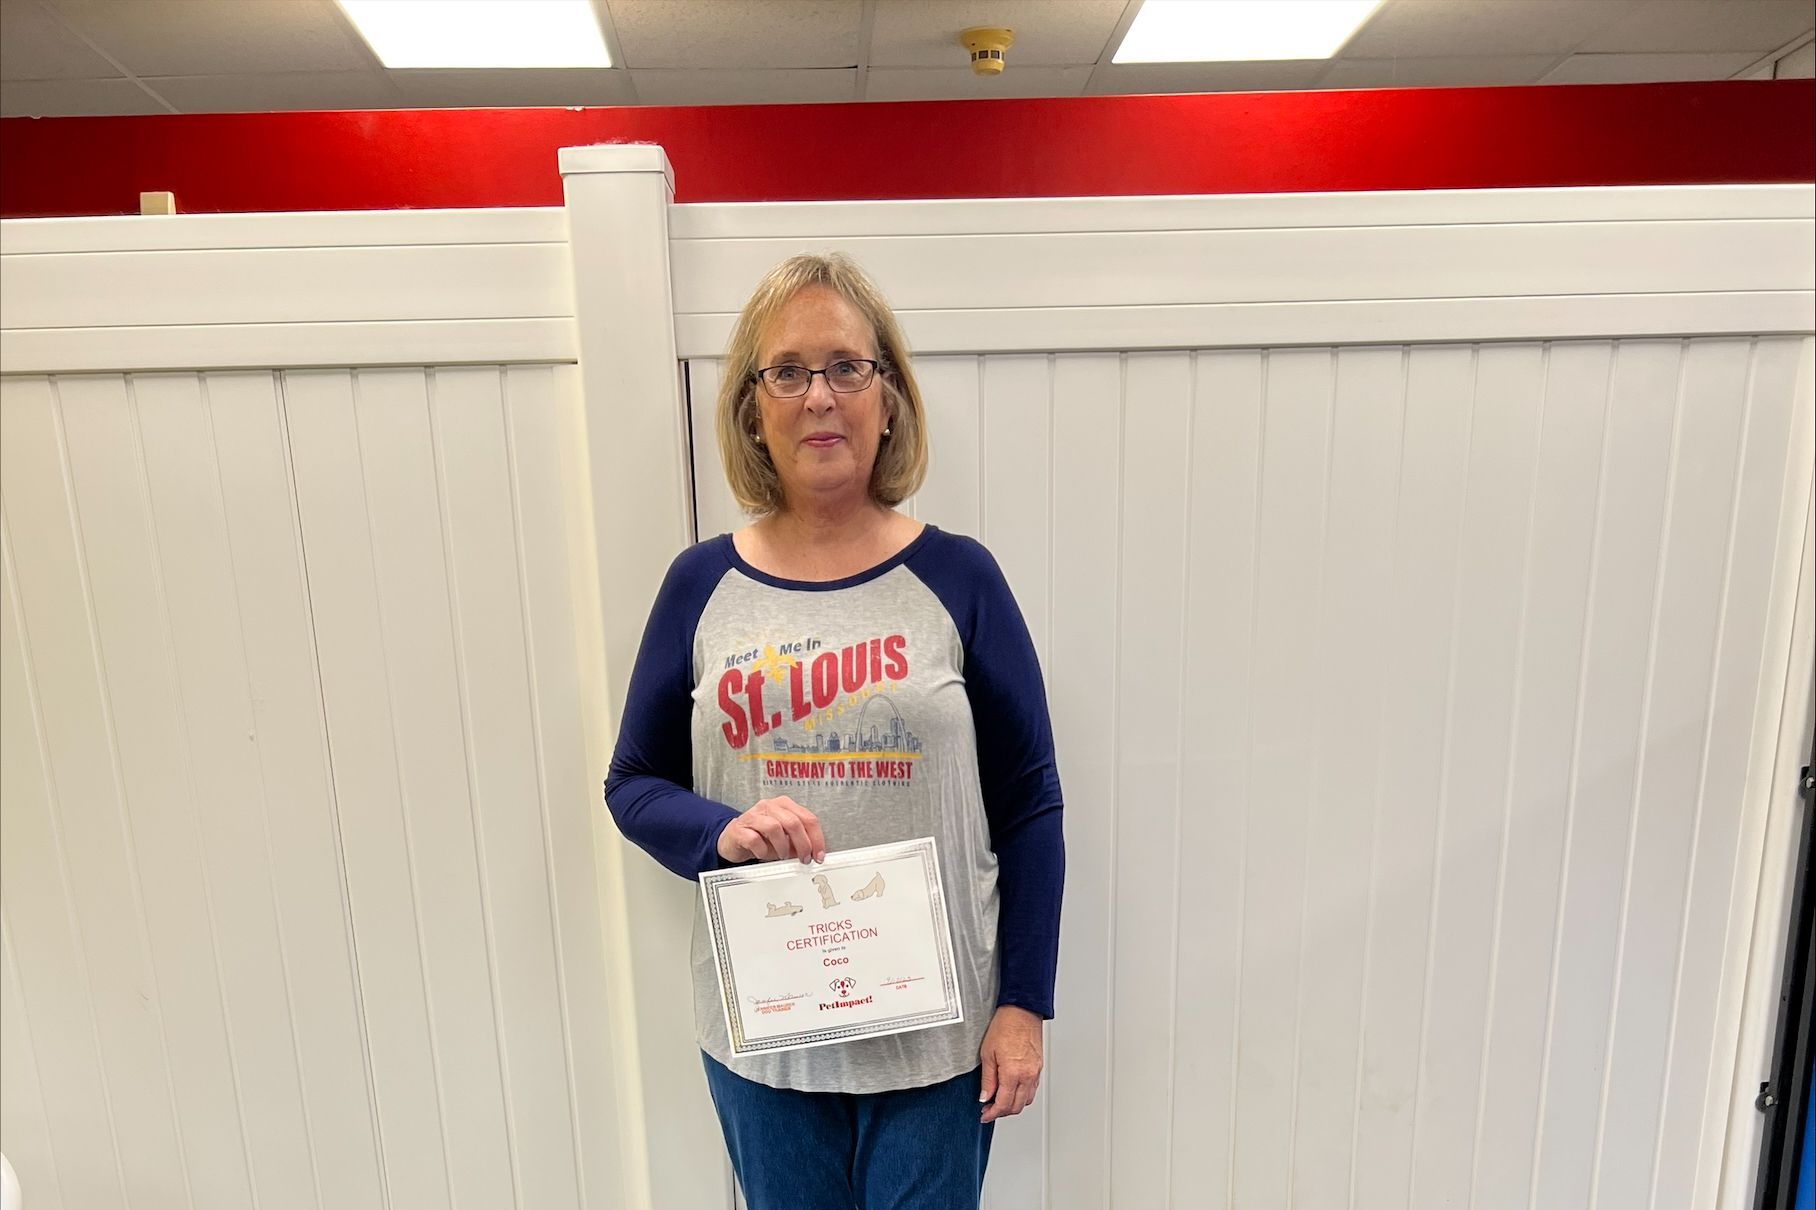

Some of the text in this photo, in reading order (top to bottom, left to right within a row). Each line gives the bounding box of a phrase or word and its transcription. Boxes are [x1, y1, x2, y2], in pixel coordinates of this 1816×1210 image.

[724, 638, 821, 669] Meet Me In
[718, 634, 908, 750] St. LOUIS
[767, 760, 913, 779] GATEWAY TO THE WEST
[808, 919, 852, 935] TRICKS
[786, 927, 878, 951] CERTIFICATION
[823, 957, 849, 967] Coco
[818, 995, 873, 1011] PetImpact!
